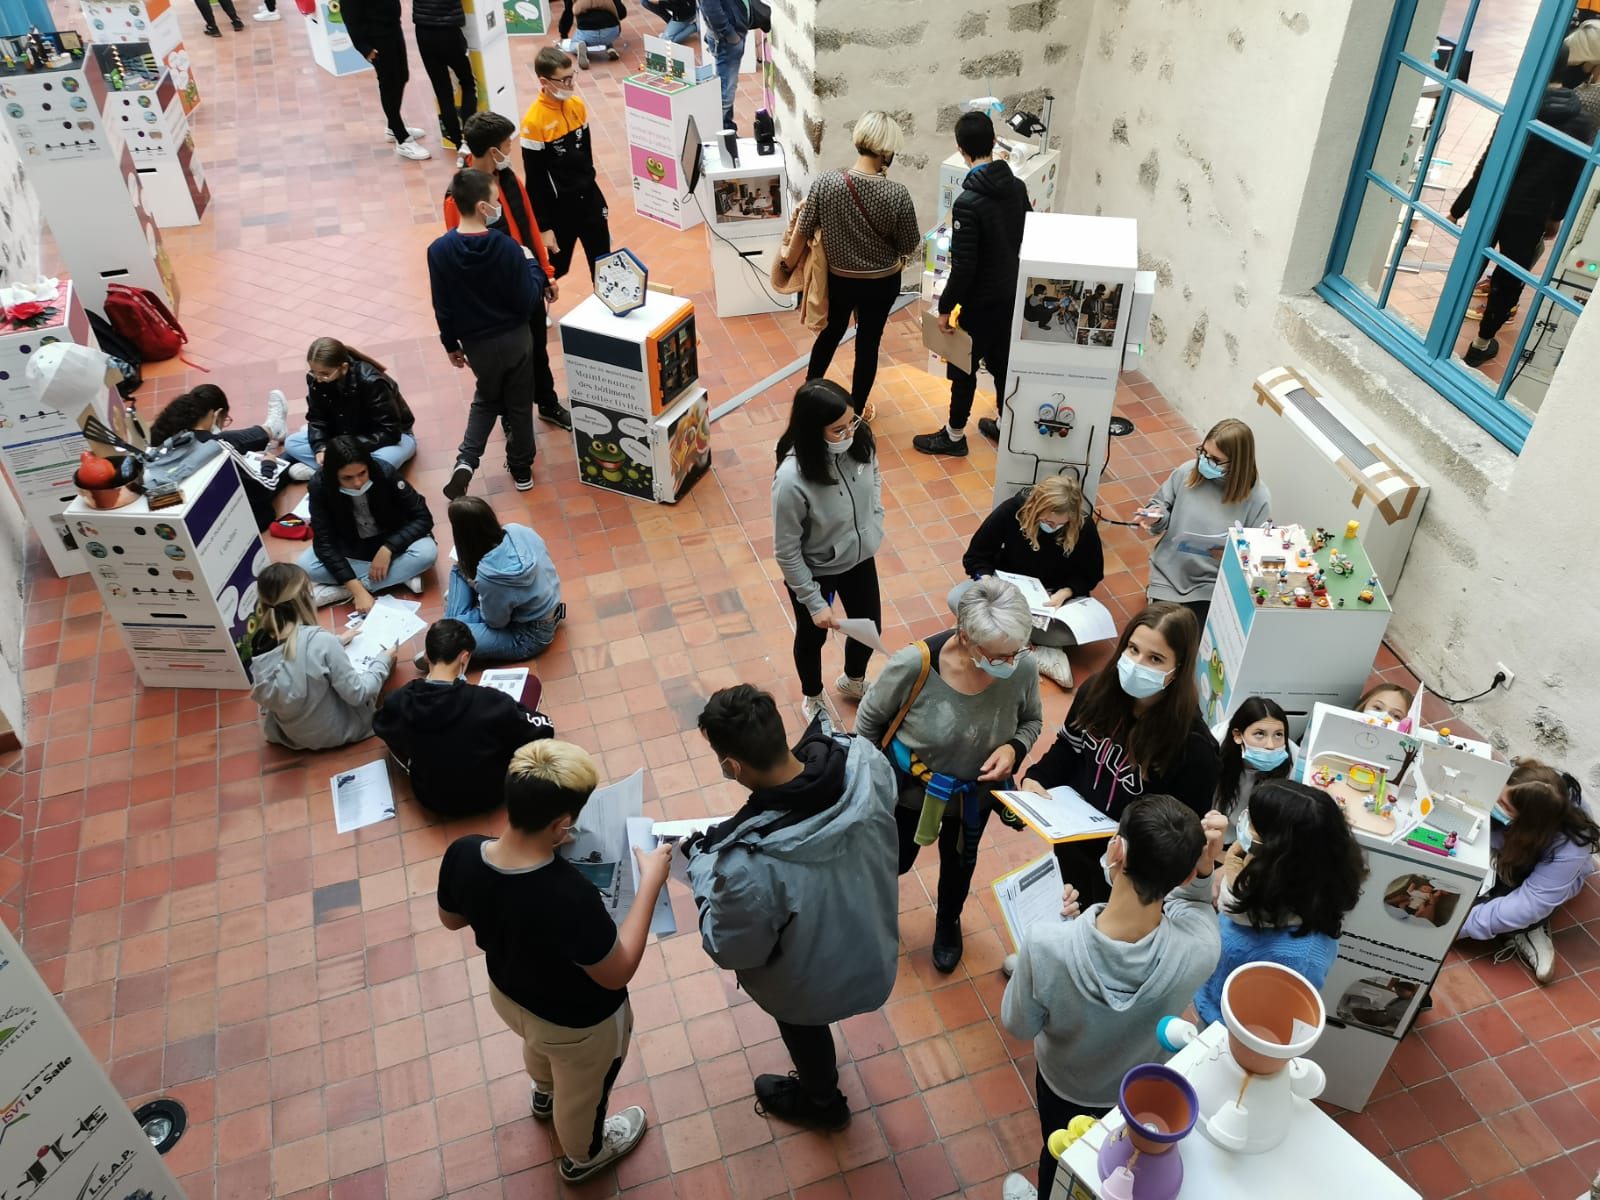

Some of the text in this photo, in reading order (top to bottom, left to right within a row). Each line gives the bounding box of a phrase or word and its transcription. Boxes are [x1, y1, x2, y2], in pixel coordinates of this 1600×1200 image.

[578, 381, 593, 390] des
[571, 388, 583, 396] de
[25, 1085, 42, 1101] La
[42, 1056, 72, 1085] Salle
